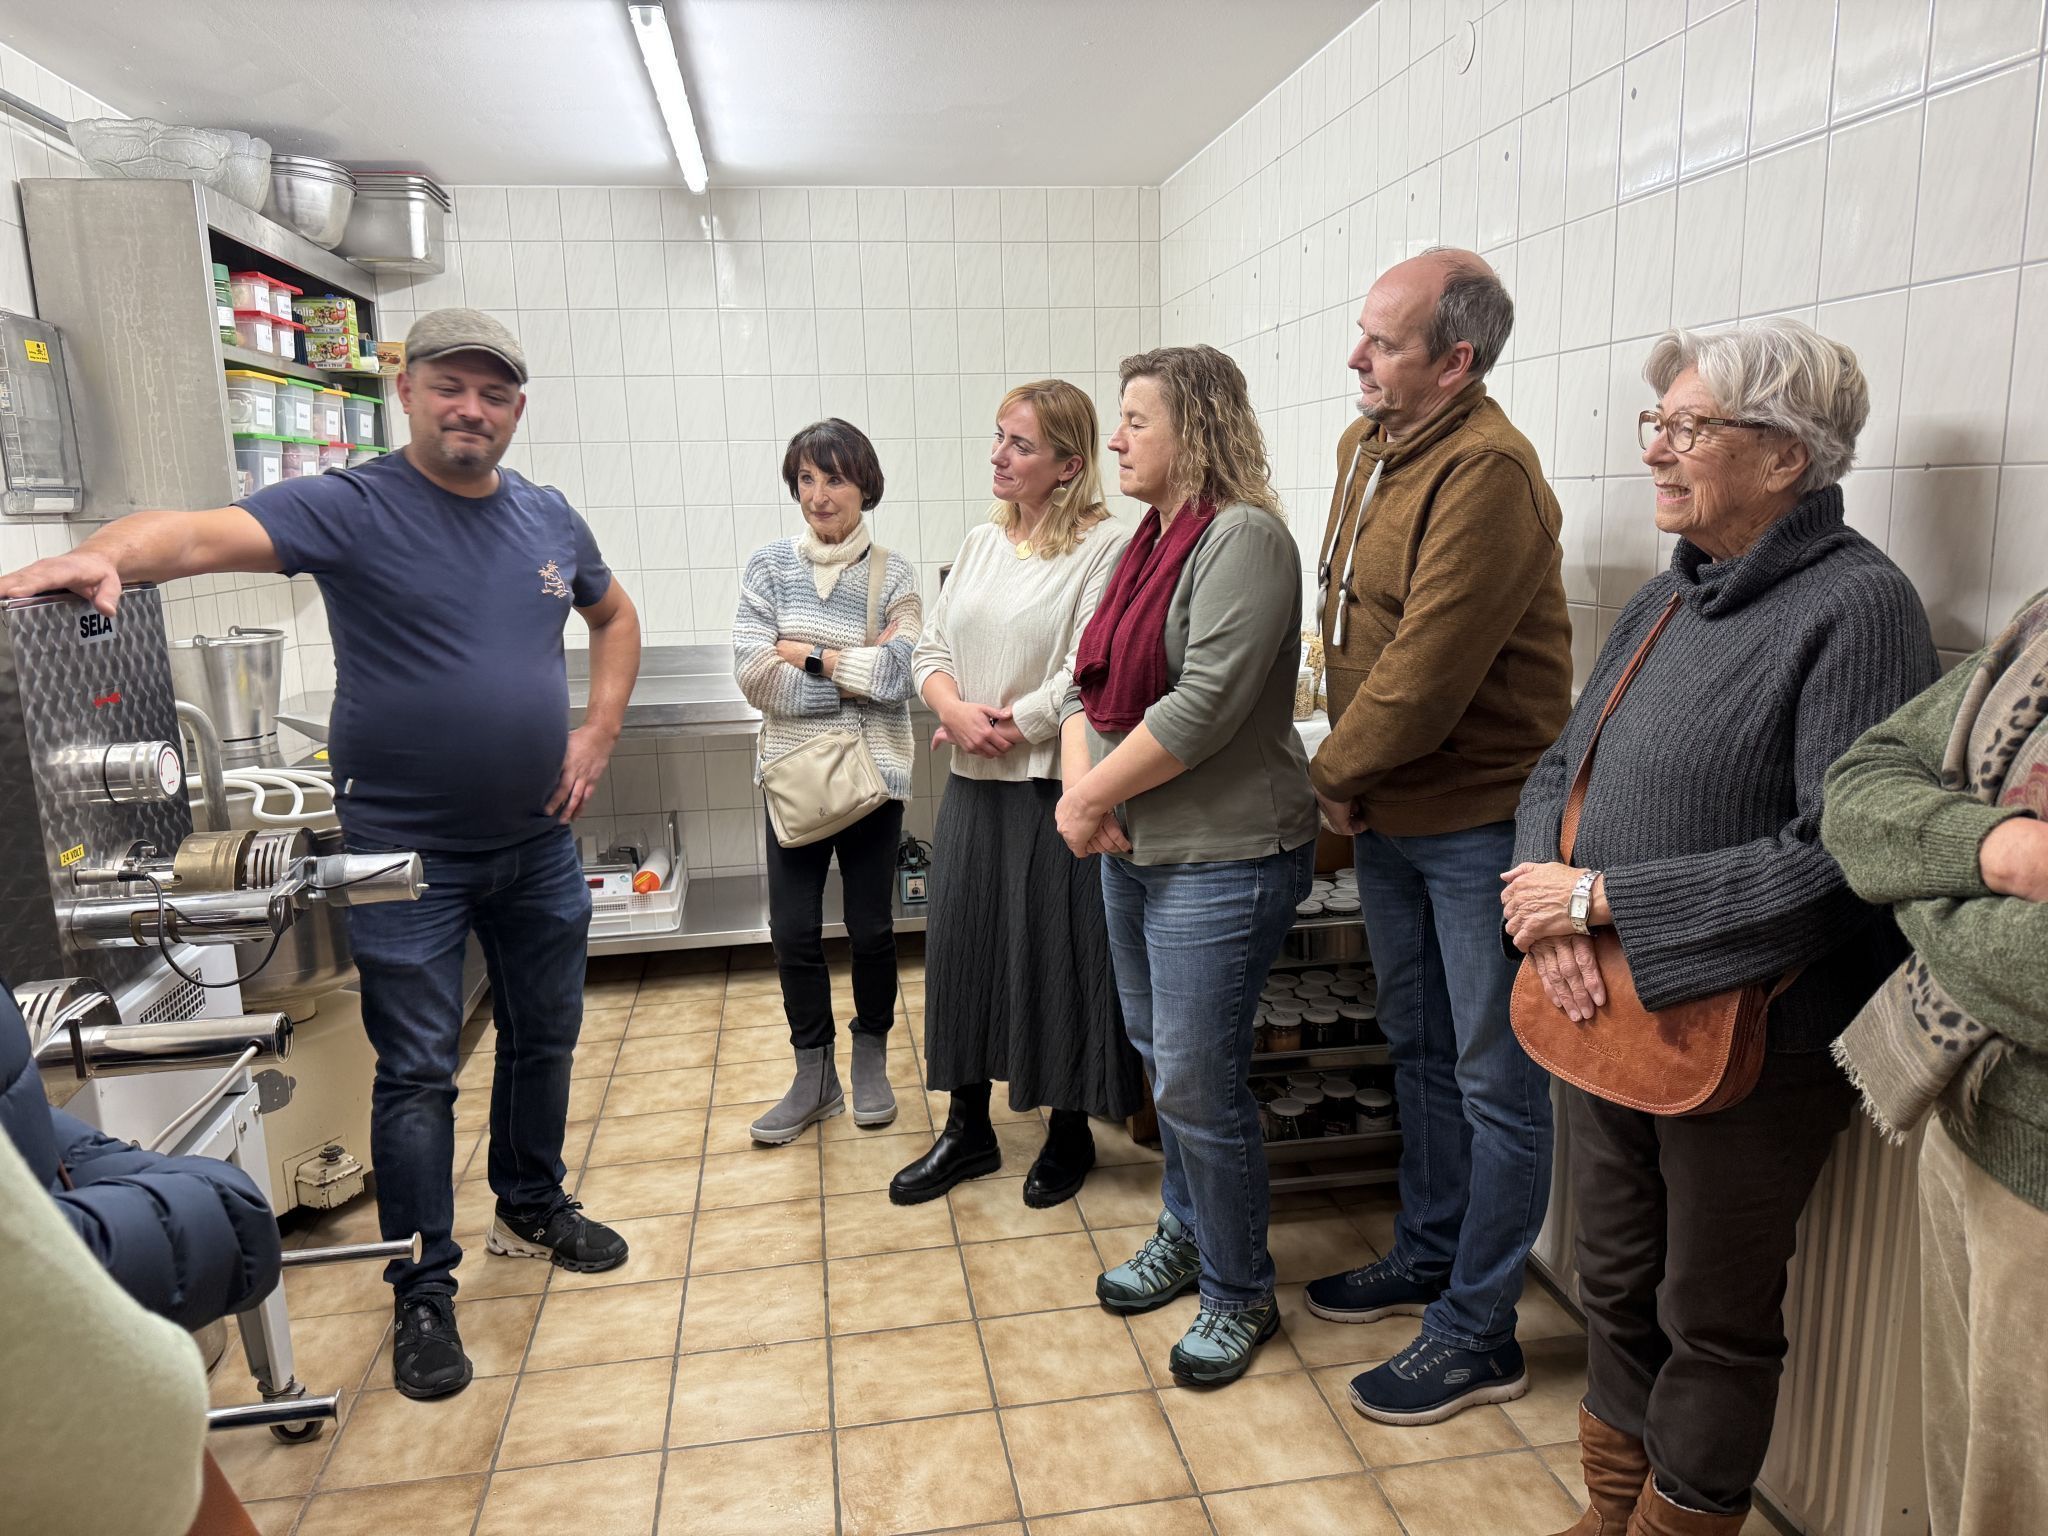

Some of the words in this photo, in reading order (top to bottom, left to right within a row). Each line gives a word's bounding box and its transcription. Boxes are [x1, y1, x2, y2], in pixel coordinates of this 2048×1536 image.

[80, 614, 113, 638] SELA
[62, 852, 70, 863] 24
[70, 847, 82, 859] VOLT
